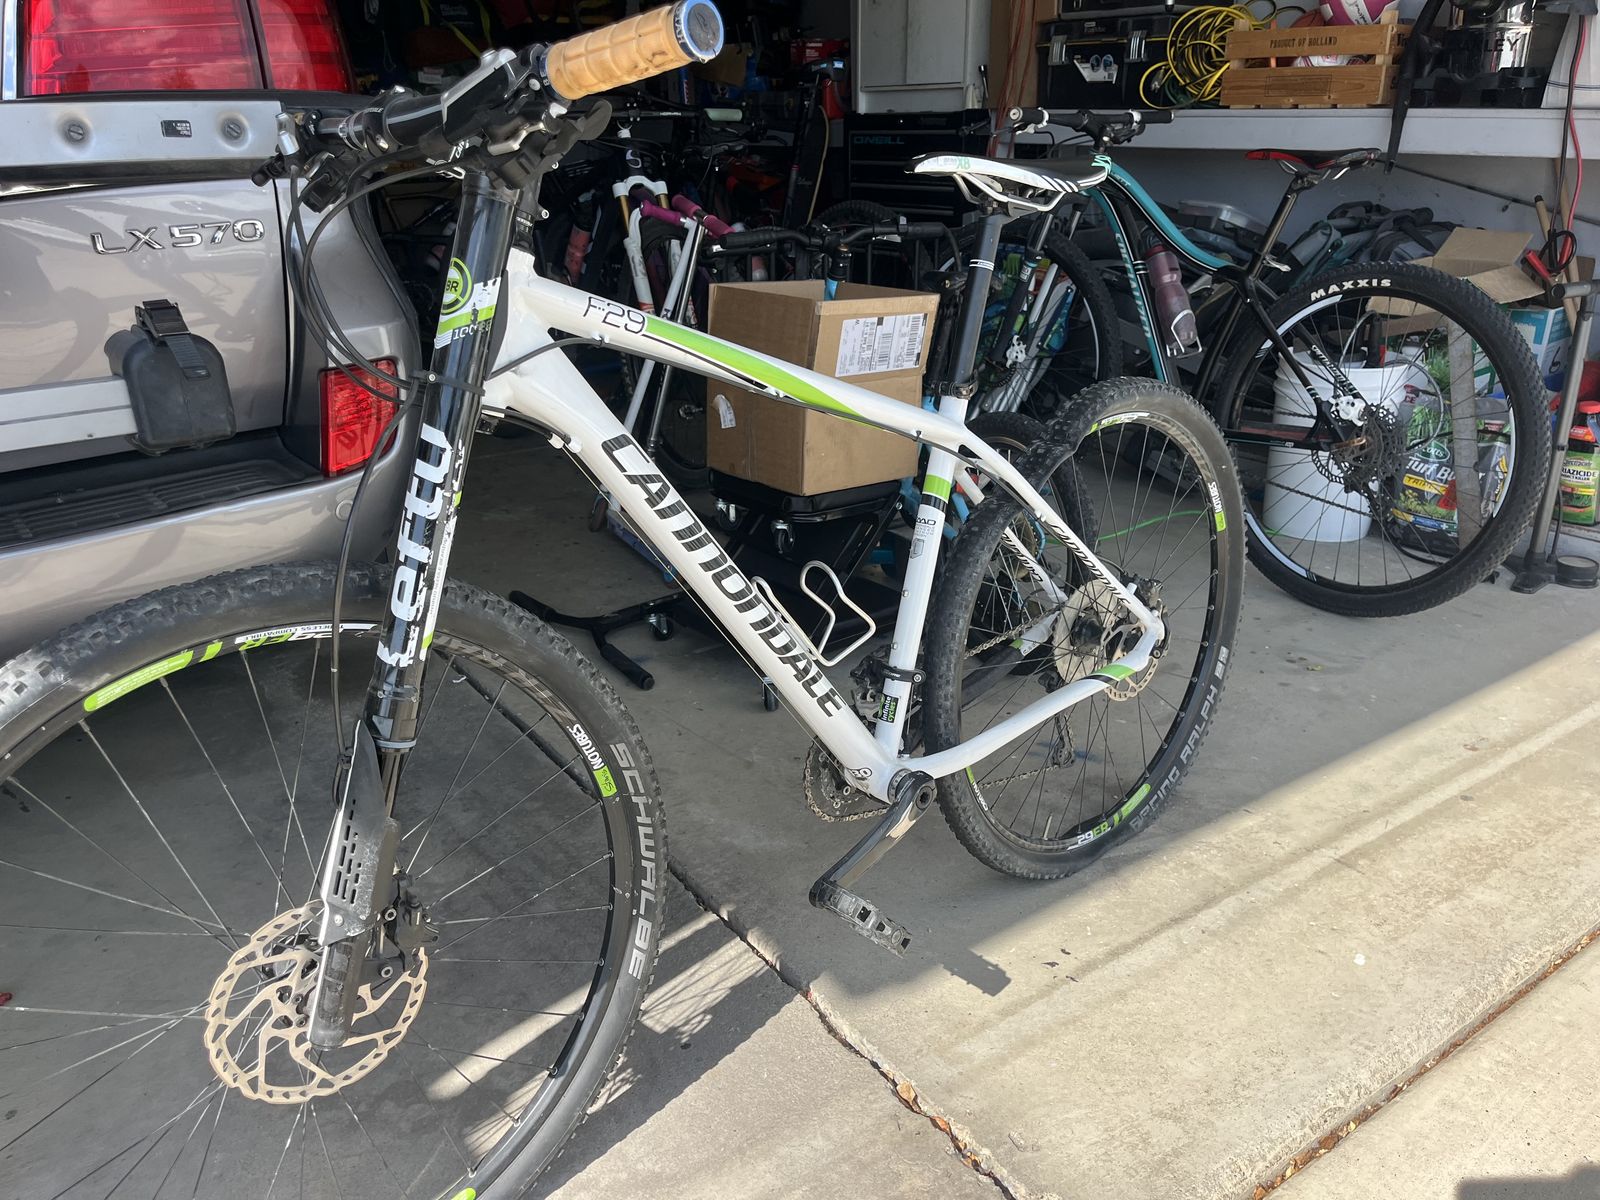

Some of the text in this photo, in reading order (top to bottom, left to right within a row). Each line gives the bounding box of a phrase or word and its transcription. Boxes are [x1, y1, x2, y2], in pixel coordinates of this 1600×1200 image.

[1269, 36, 1338, 49] PRODUCT OF HOLLAND
[90, 219, 265, 255] LX 570
[1310, 278, 1392, 302] MAXXIS
[1405, 455, 1440, 475] Turf
[601, 434, 843, 717] CANNONDALE
[1050, 524, 1132, 605] CANNONDALE
[567, 723, 605, 771] NOTUBES
[1129, 684, 1218, 832] RACING RALPH
[1077, 820, 1110, 847] 29ER
[610, 742, 656, 980] SCHWALBE
